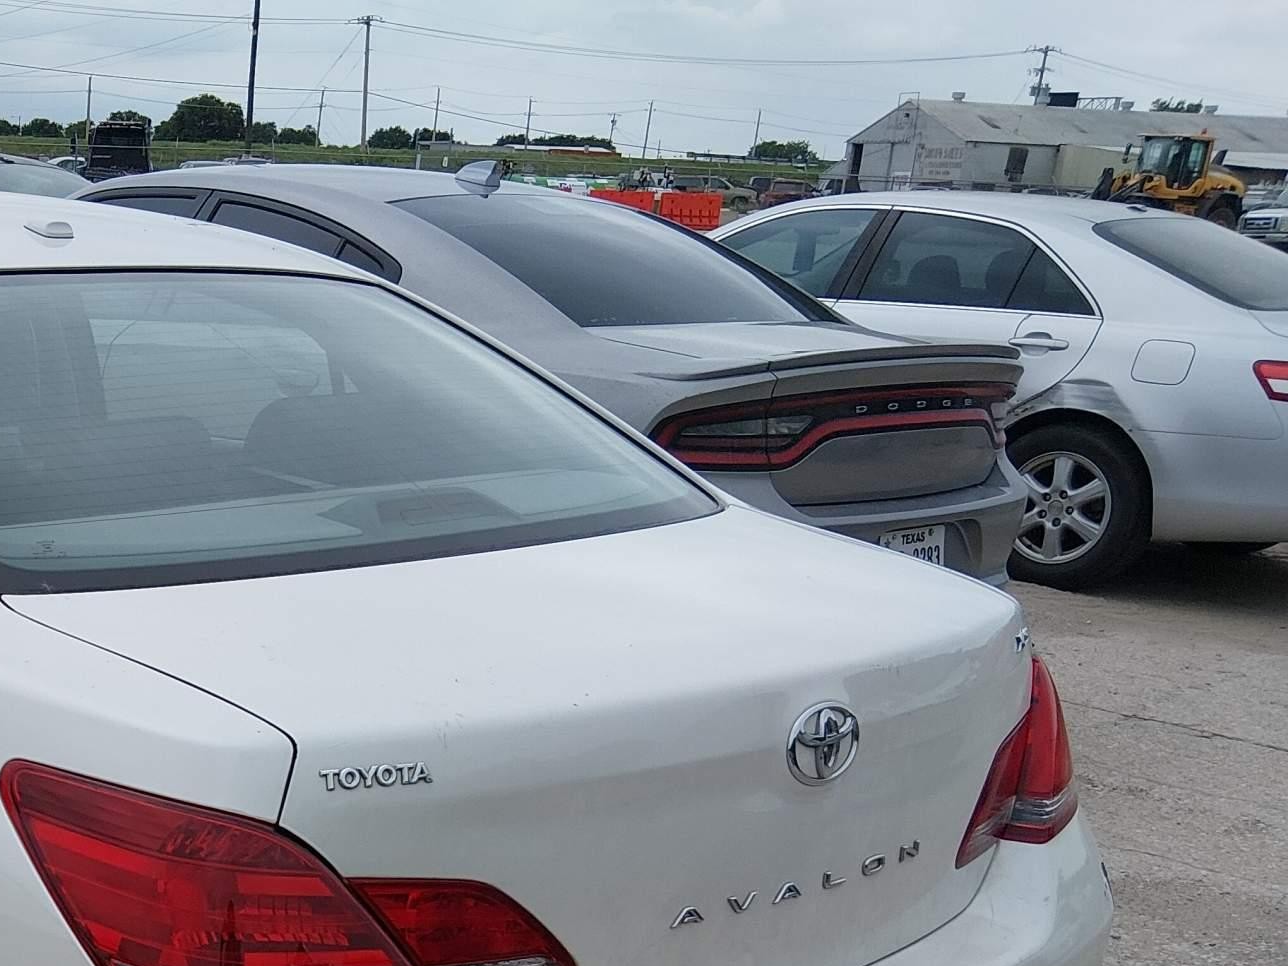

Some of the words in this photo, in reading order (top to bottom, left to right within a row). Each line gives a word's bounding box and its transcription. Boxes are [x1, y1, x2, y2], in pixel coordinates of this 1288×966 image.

[855, 398, 973, 413] DODGE
[901, 531, 926, 545] TEXAS
[319, 762, 430, 791] TOYOTA
[670, 839, 921, 929] AVALON
